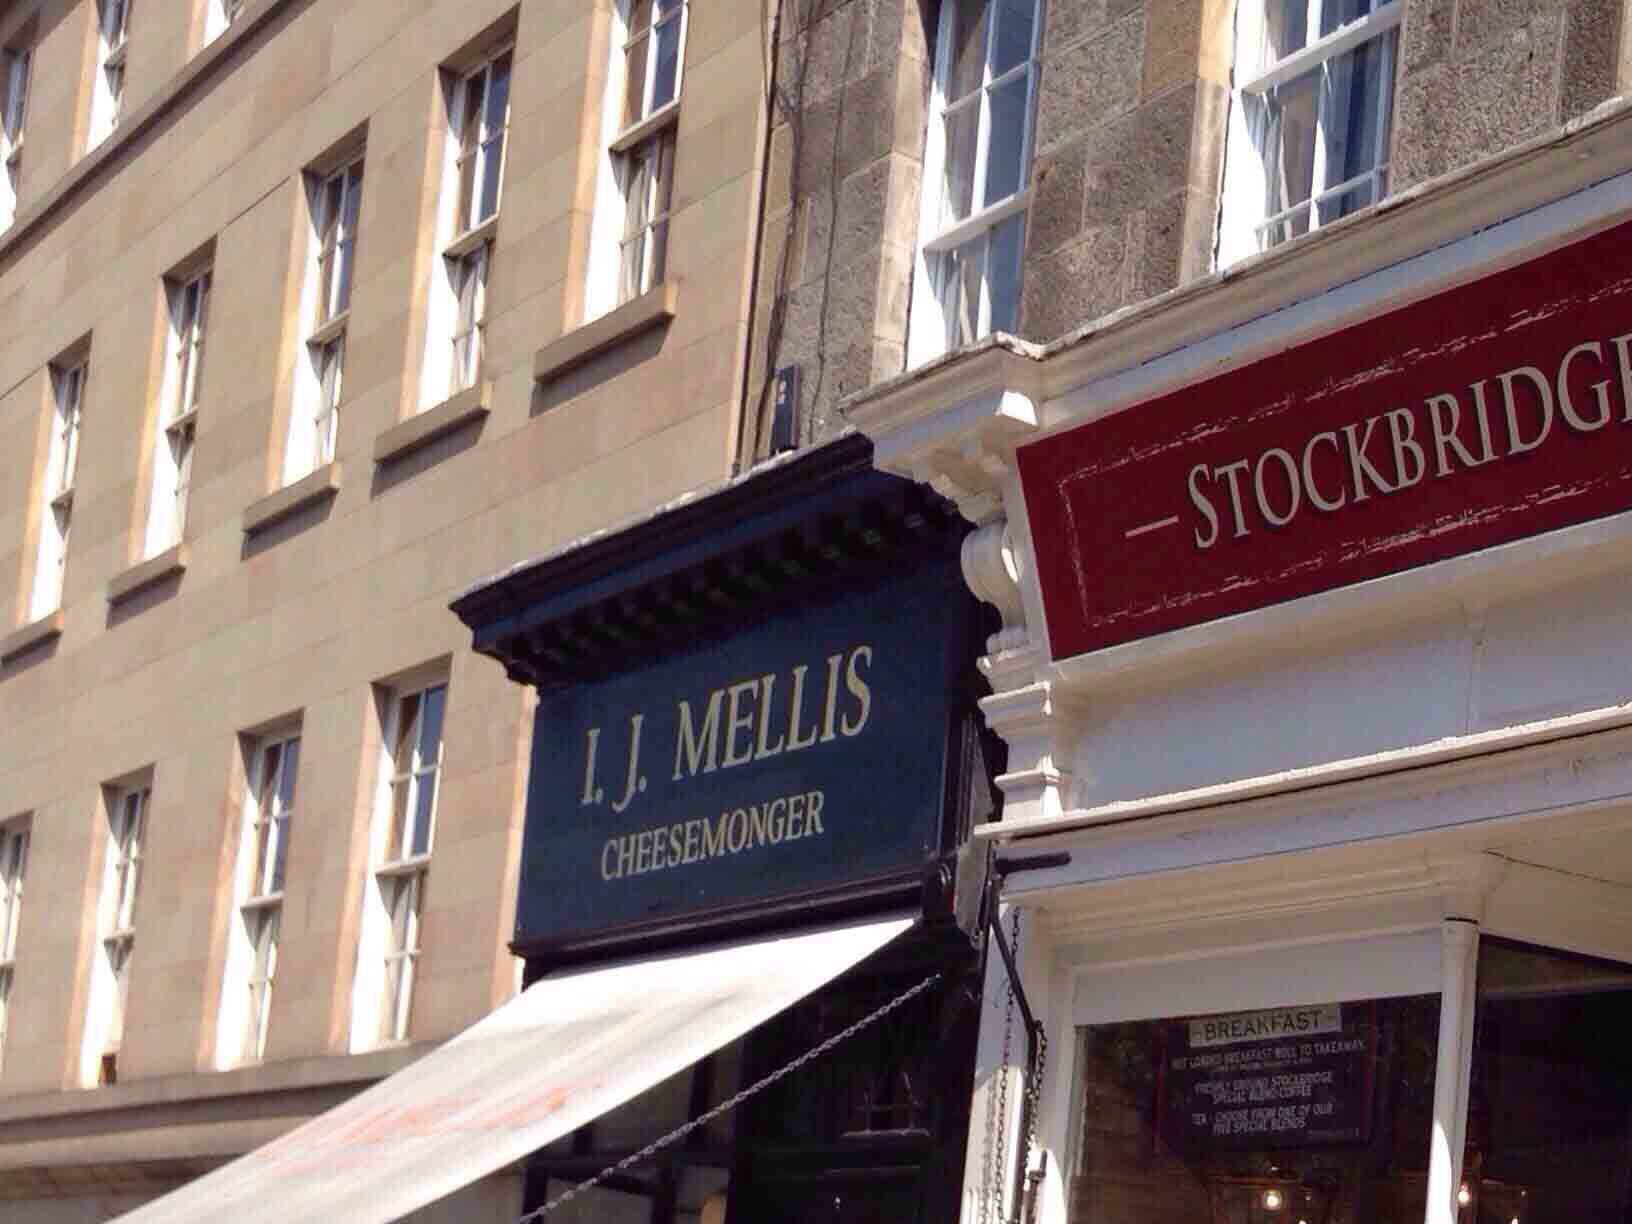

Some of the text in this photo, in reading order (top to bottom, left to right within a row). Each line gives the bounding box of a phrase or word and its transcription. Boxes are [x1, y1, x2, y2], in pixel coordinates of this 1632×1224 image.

[672, 646, 874, 781] MELLIS
[601, 791, 825, 882] CHEESEMONGER
[1204, 1009, 1324, 1041] BREAKFAST
